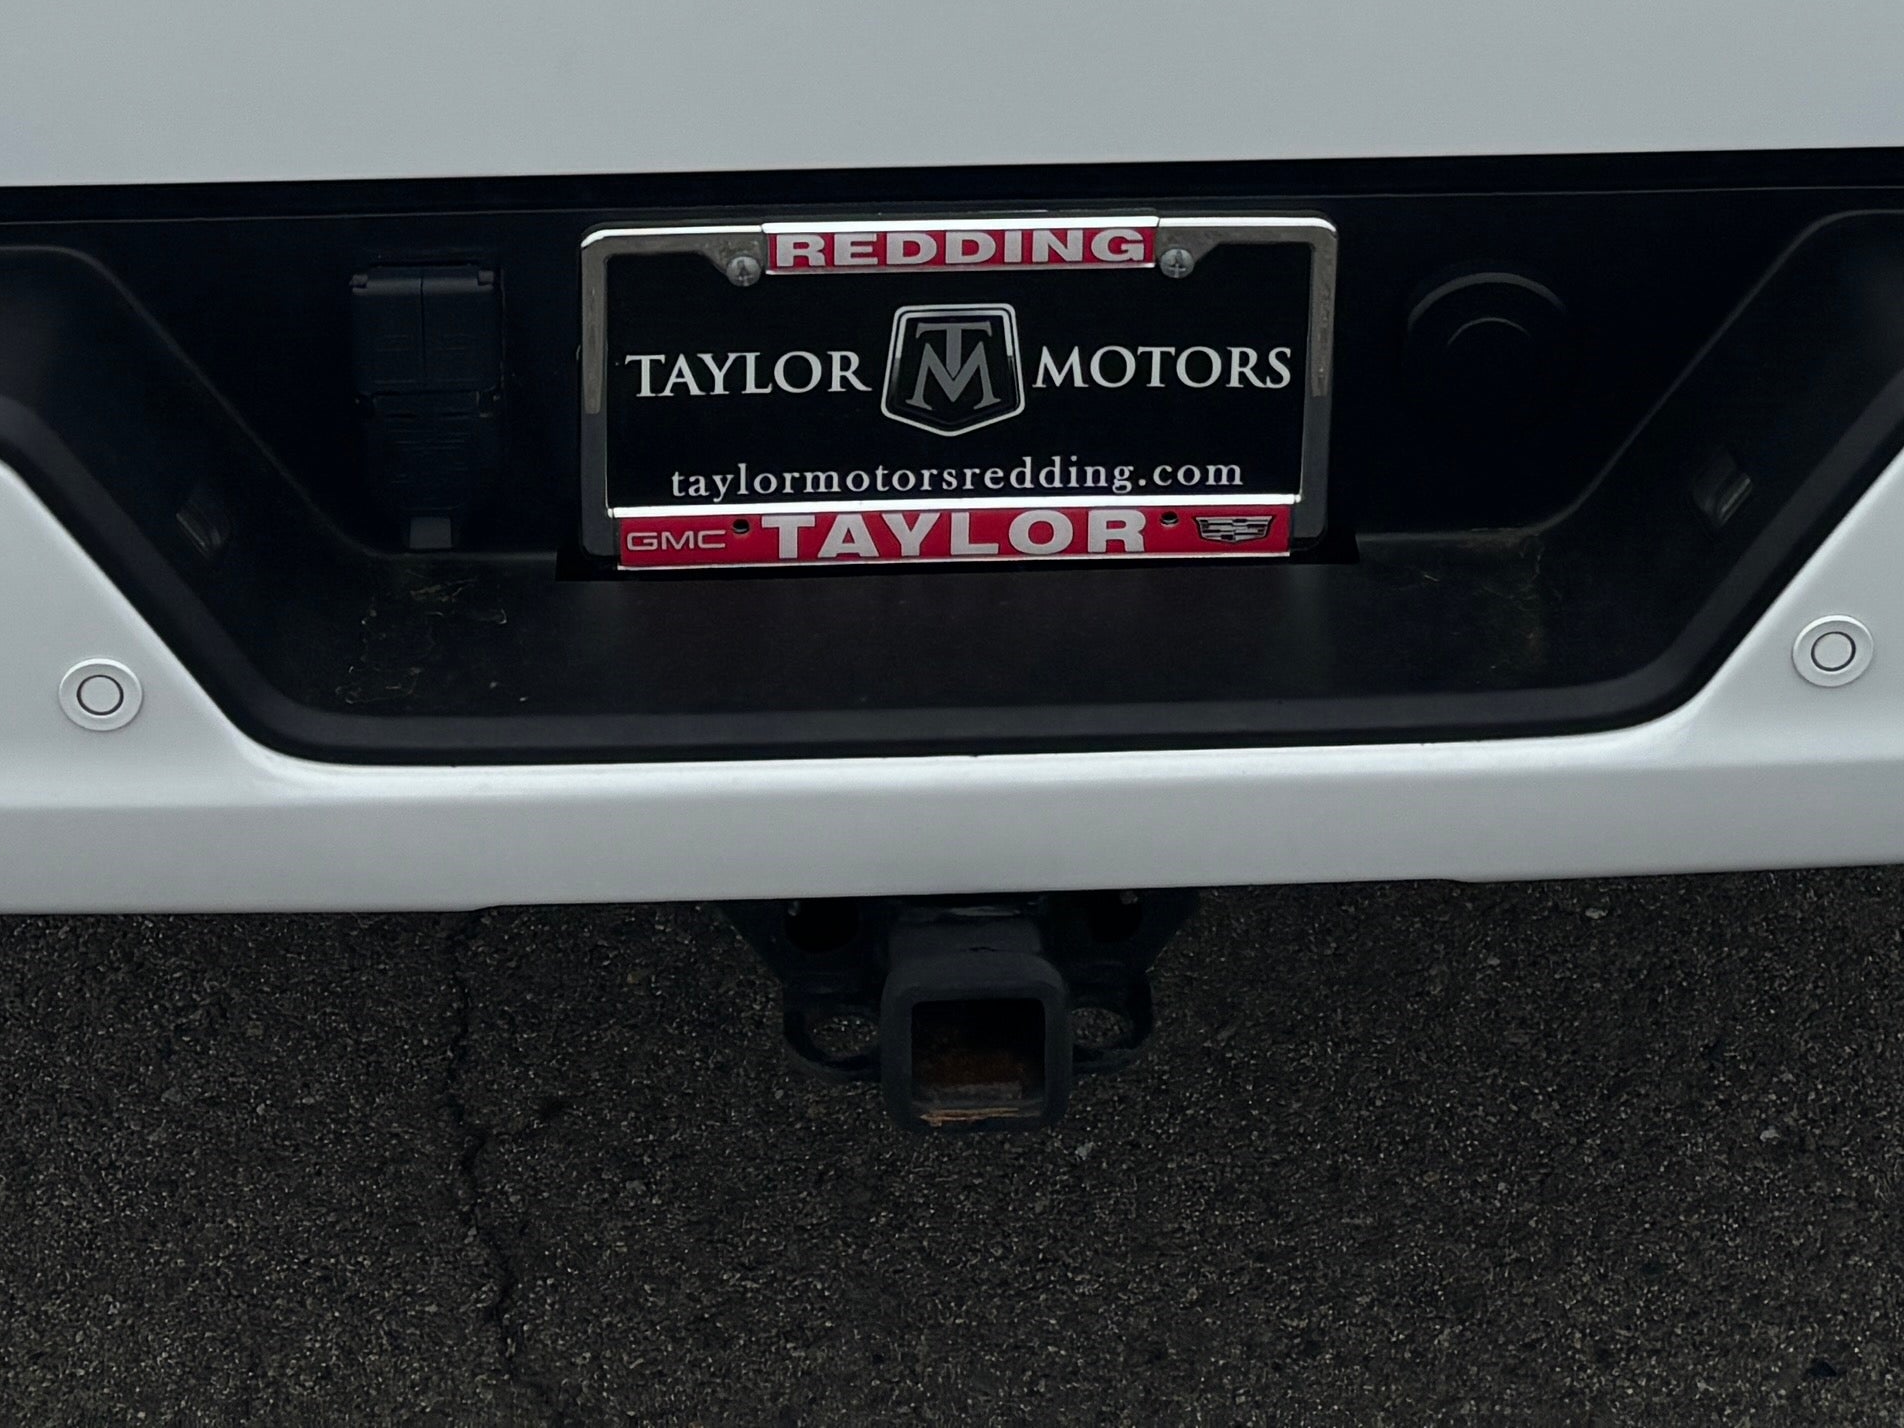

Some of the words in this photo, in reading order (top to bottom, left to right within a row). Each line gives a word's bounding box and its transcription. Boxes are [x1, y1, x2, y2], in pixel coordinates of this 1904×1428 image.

[774, 228, 1148, 269] REDDING
[625, 351, 872, 399] TAYLOR
[1031, 344, 1293, 390] MOTORS
[670, 456, 1244, 504] taylormotorsredding.com
[625, 528, 728, 553] GMC
[761, 507, 1147, 561] TAYLOR
